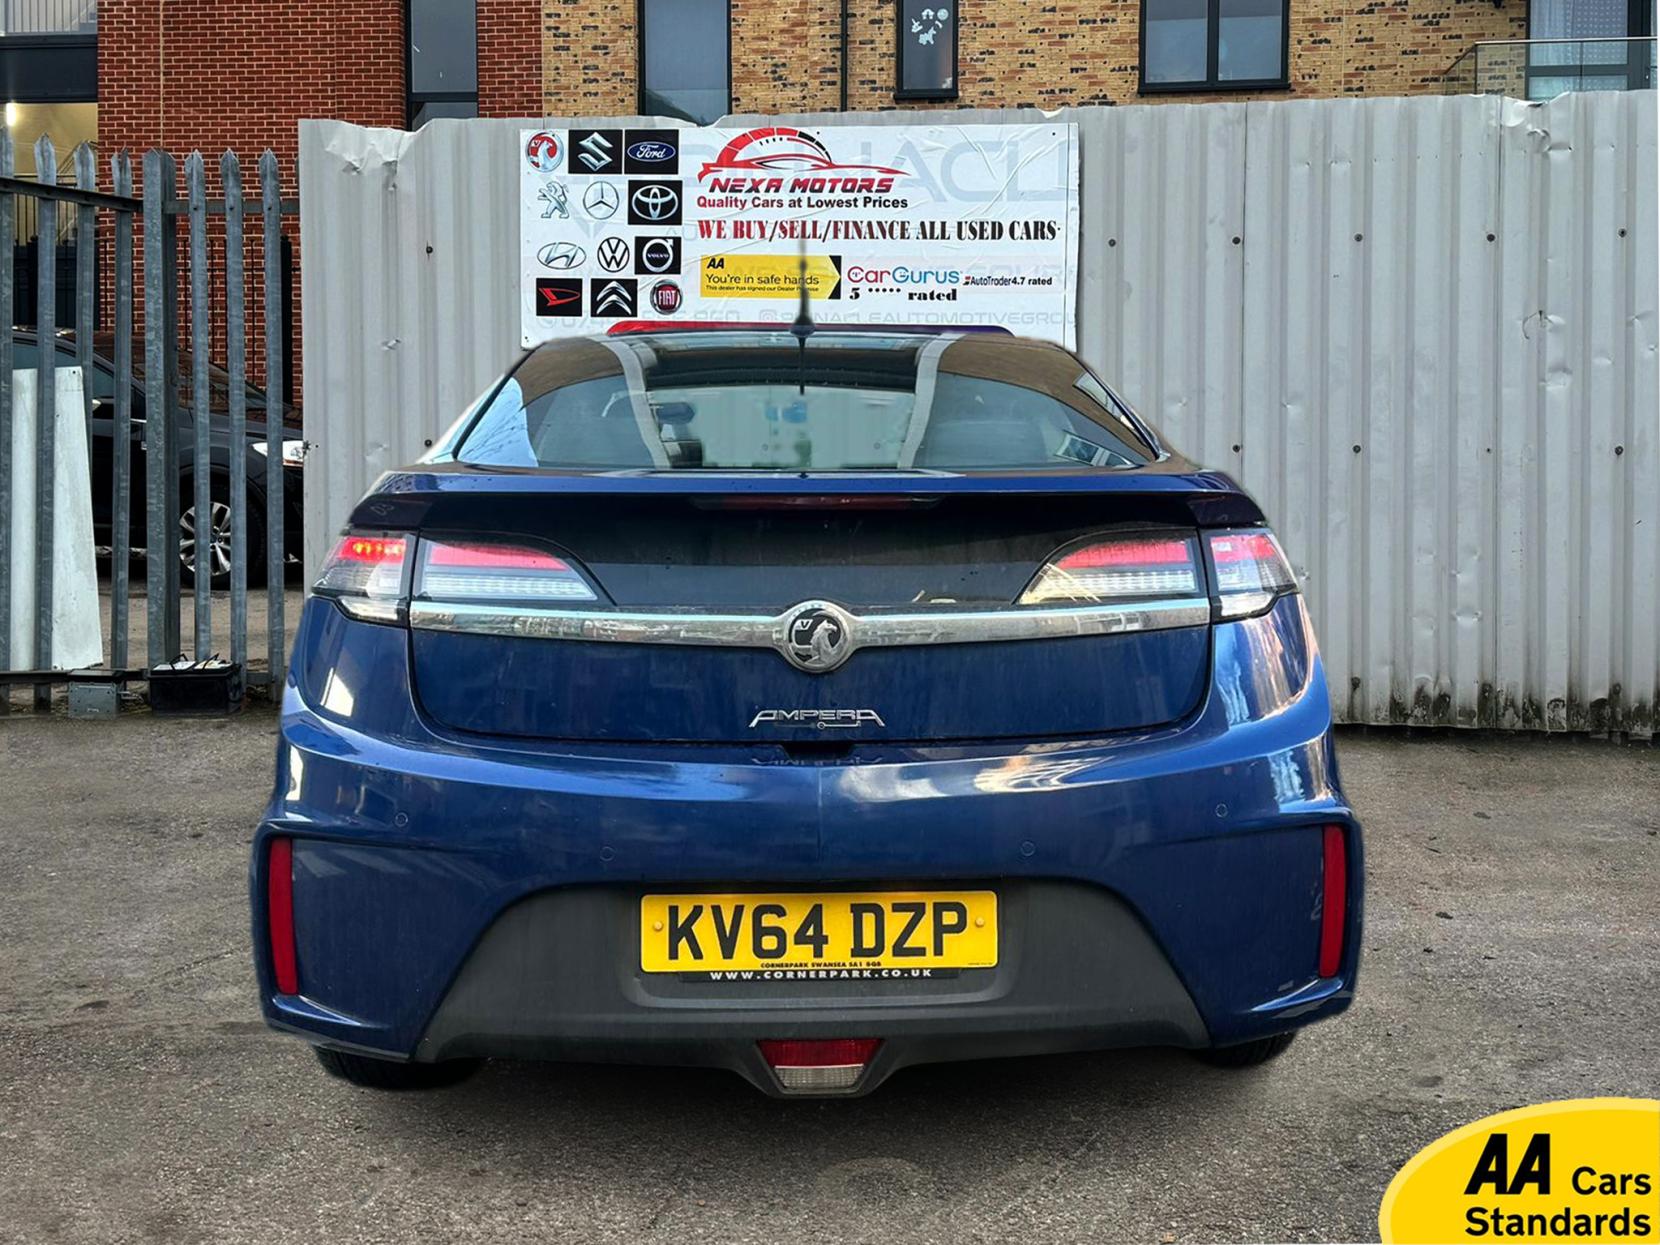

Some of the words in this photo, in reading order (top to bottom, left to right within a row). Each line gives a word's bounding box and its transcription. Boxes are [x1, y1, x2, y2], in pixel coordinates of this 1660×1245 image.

[636, 144, 666, 159] Ford
[709, 178, 784, 193] NEXA
[789, 178, 894, 193] MOTORS
[697, 196, 747, 211] Quality
[752, 197, 784, 208] Cars
[788, 197, 803, 208] at
[807, 197, 858, 208] Lowest
[863, 196, 908, 208] Prices
[698, 220, 727, 239] WE
[916, 220, 950, 240] ALL
[957, 220, 1004, 240] USED
[707, 258, 725, 269] AA
[705, 274, 741, 284] You're
[744, 274, 754, 284] in
[757, 274, 781, 285] safe
[847, 266, 960, 284] CarGurus
[1028, 277, 1053, 286] rated
[658, 290, 676, 306] FIAT
[849, 287, 860, 300] 5
[908, 288, 957, 301] rated
[749, 709, 885, 728] AMPERA
[668, 904, 829, 961] KV64
[850, 902, 967, 958] DZP
[710, 969, 932, 980] WWW.CORNERPARK.CO.UK
